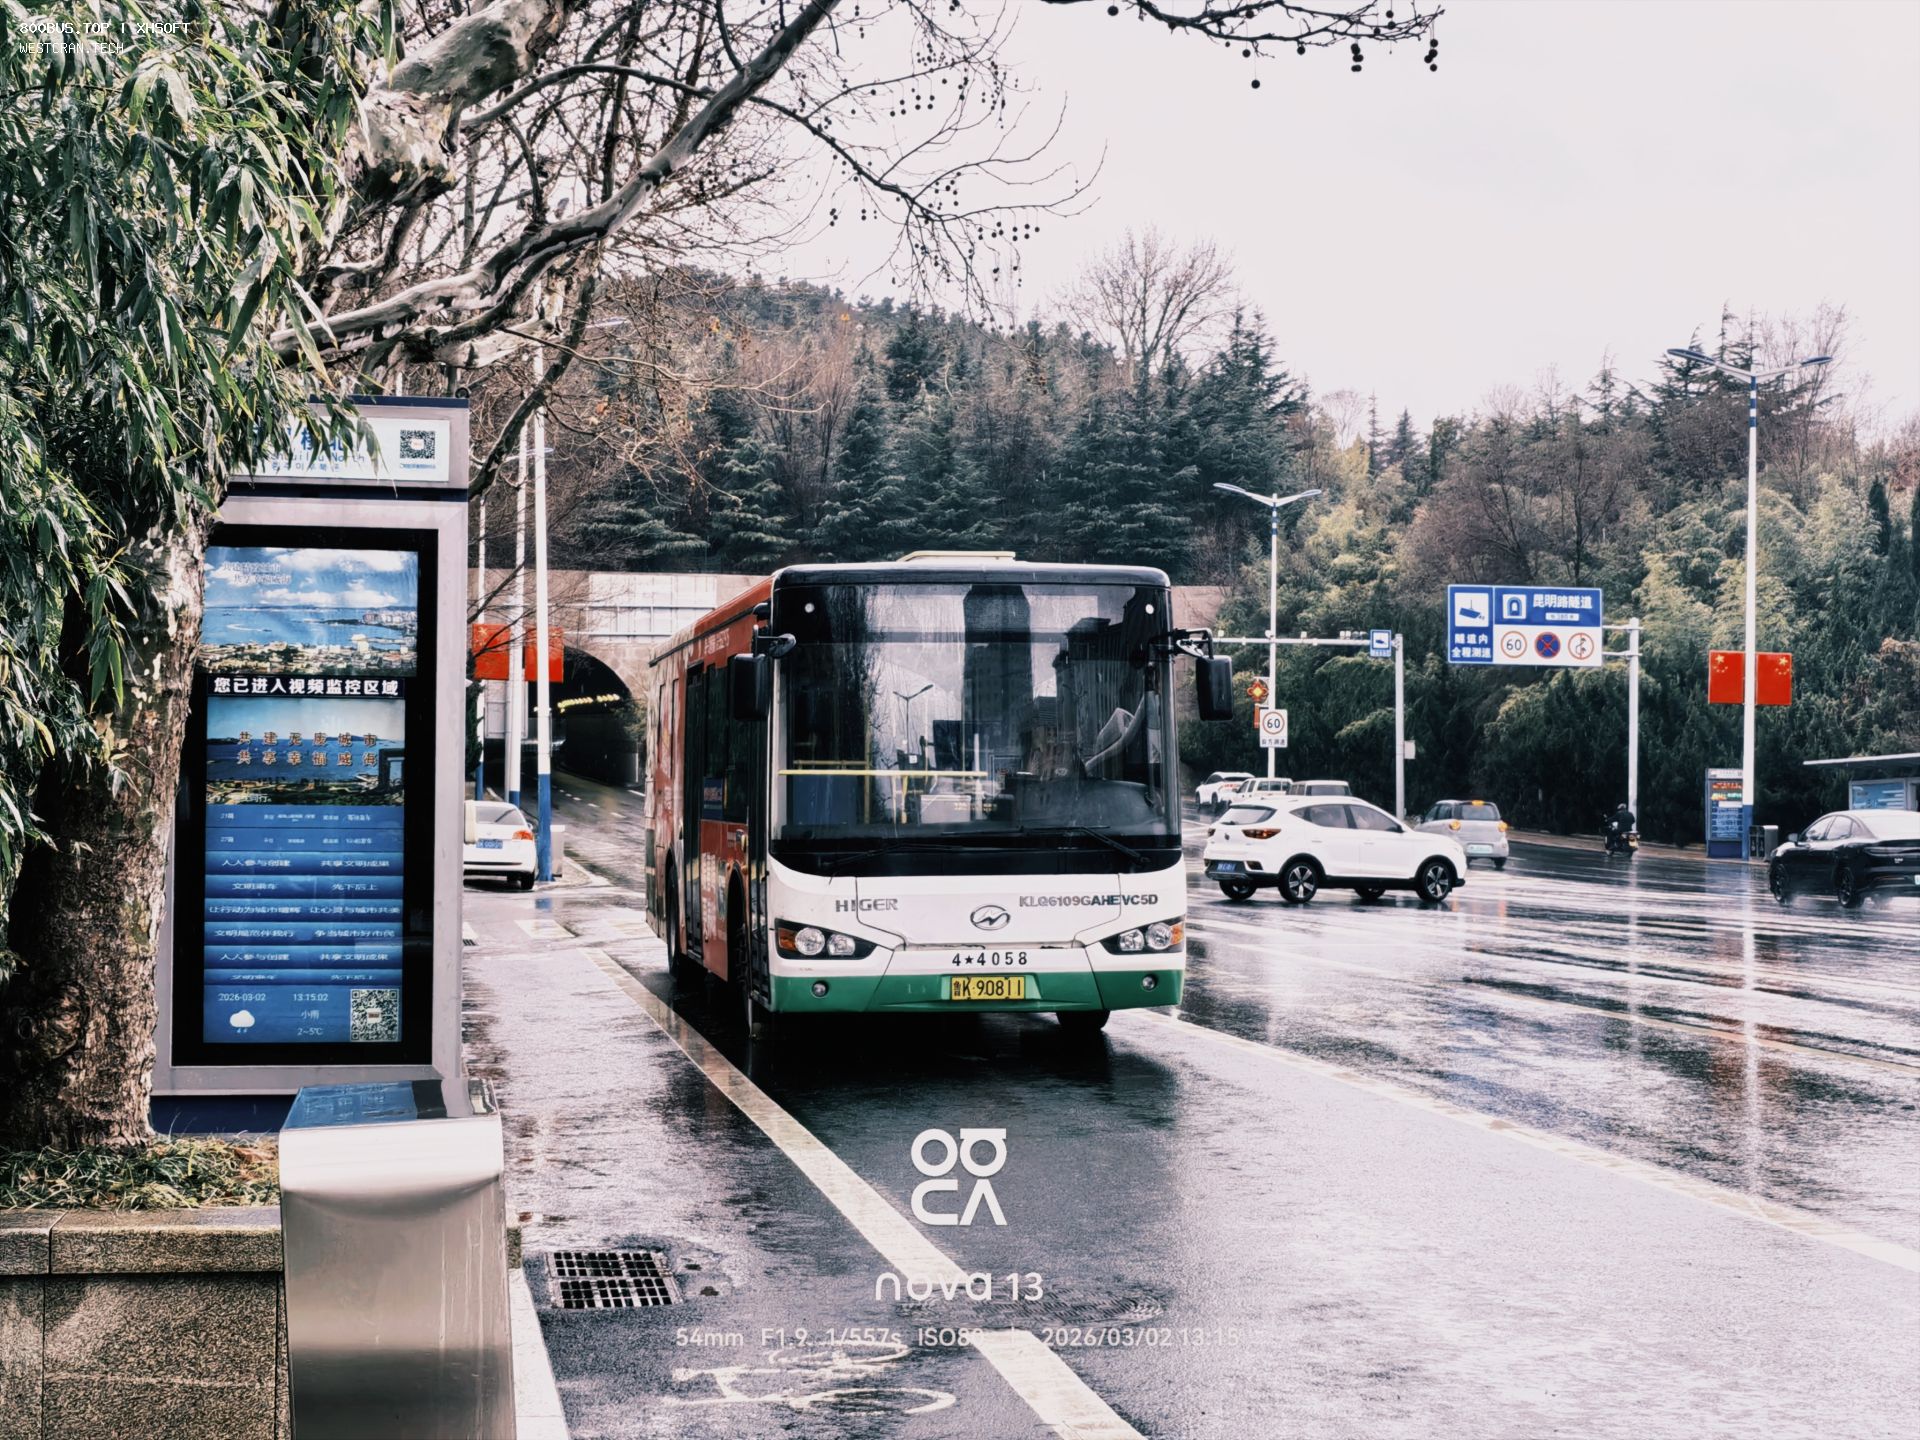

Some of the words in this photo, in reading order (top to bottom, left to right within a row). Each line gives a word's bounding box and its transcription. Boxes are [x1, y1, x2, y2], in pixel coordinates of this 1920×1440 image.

[1533, 593, 1593, 609] 昆明路隧道
[1506, 639, 1522, 651] 60
[214, 676, 399, 696] 您已进入视频监控区域
[1267, 718, 1281, 729] 60
[236, 749, 378, 767] 共享幸福威海
[835, 898, 899, 912] HIGER
[218, 993, 267, 1001] 2026-03-02
[301, 1009, 320, 1020] 小雨
